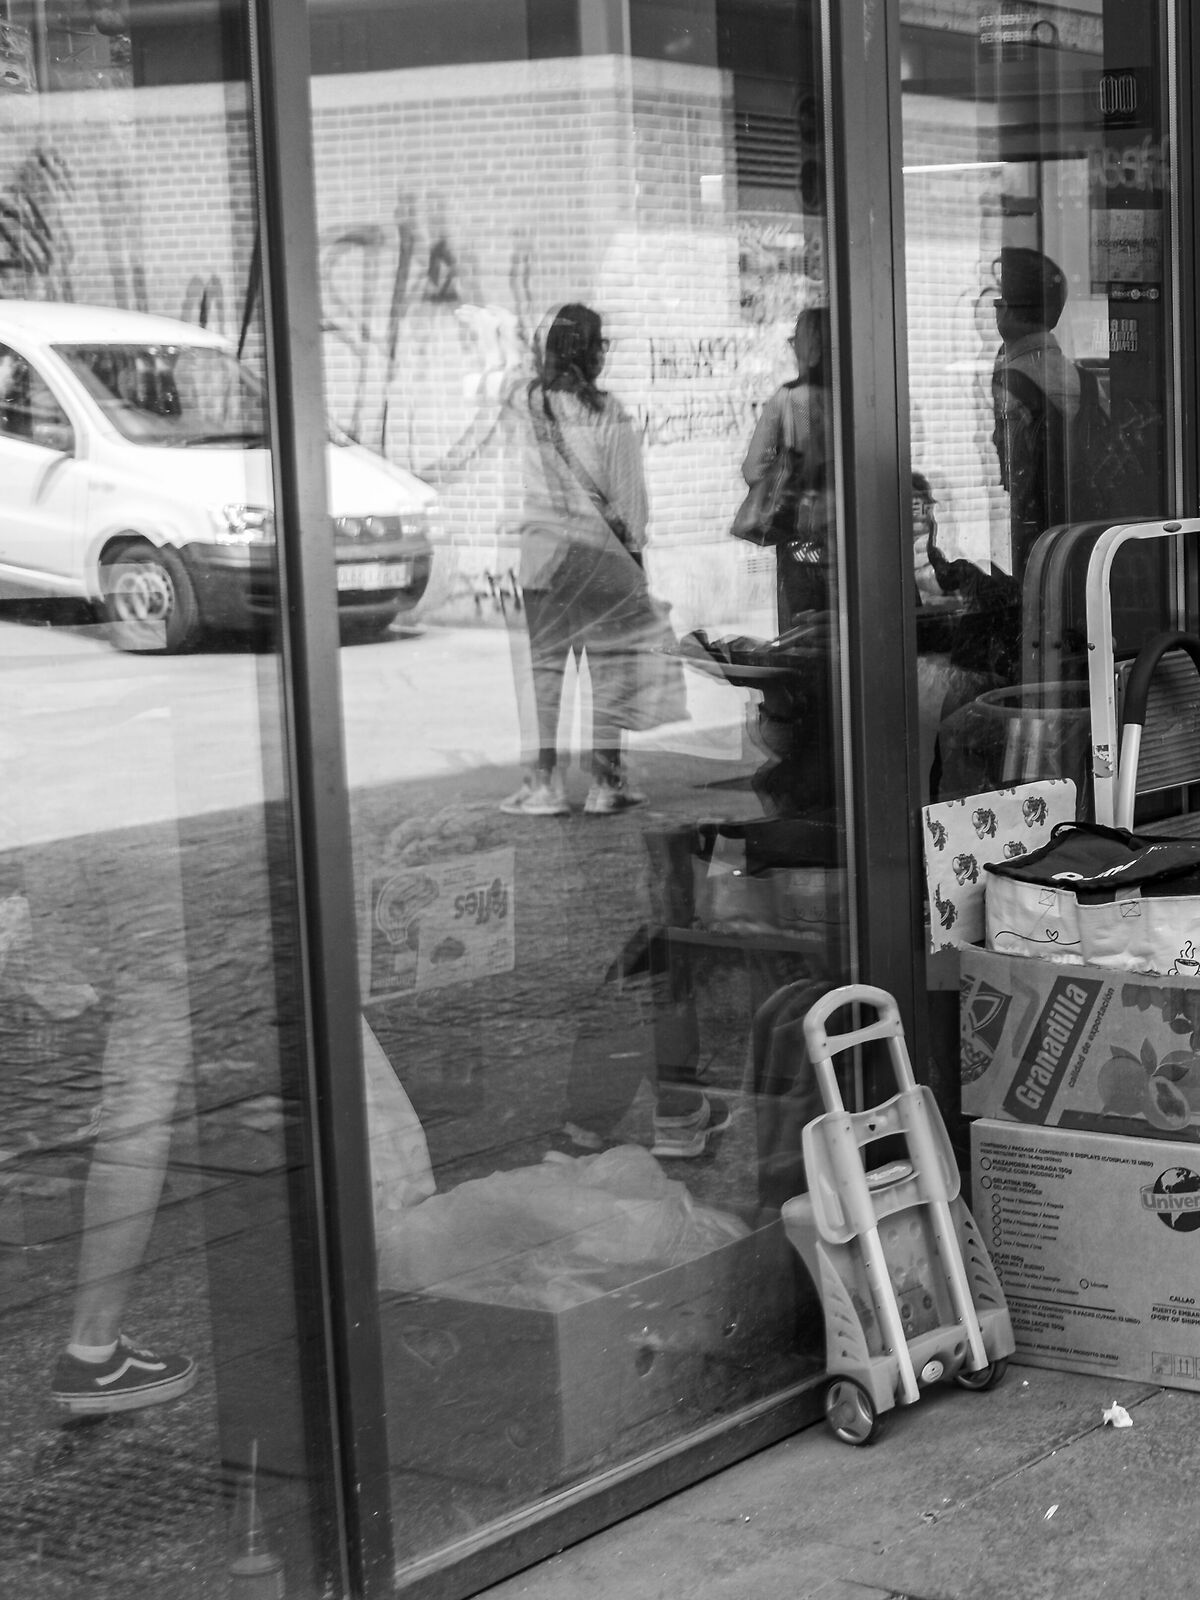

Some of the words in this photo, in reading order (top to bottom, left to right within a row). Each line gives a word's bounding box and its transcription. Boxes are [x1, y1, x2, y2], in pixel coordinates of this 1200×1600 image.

[1068, 1054, 1086, 1088] calidad
[1082, 1041, 1092, 1054] de
[1088, 987, 1115, 1041] exportación
[1016, 983, 1088, 1110] Granadilla
[1075, 1152, 1101, 1161] DISPLAYS
[992, 1159, 1029, 1169] MAZAMORRA
[1031, 1163, 1057, 1172] MORADA
[1058, 1167, 1073, 1175] 150g
[993, 1177, 1021, 1187] GELATINA
[1169, 1295, 1196, 1304] CALLAO
[1152, 1306, 1178, 1315] PUERTO
[1150, 1313, 1170, 1322] (PORT
[1171, 1315, 1181, 1323] OF
